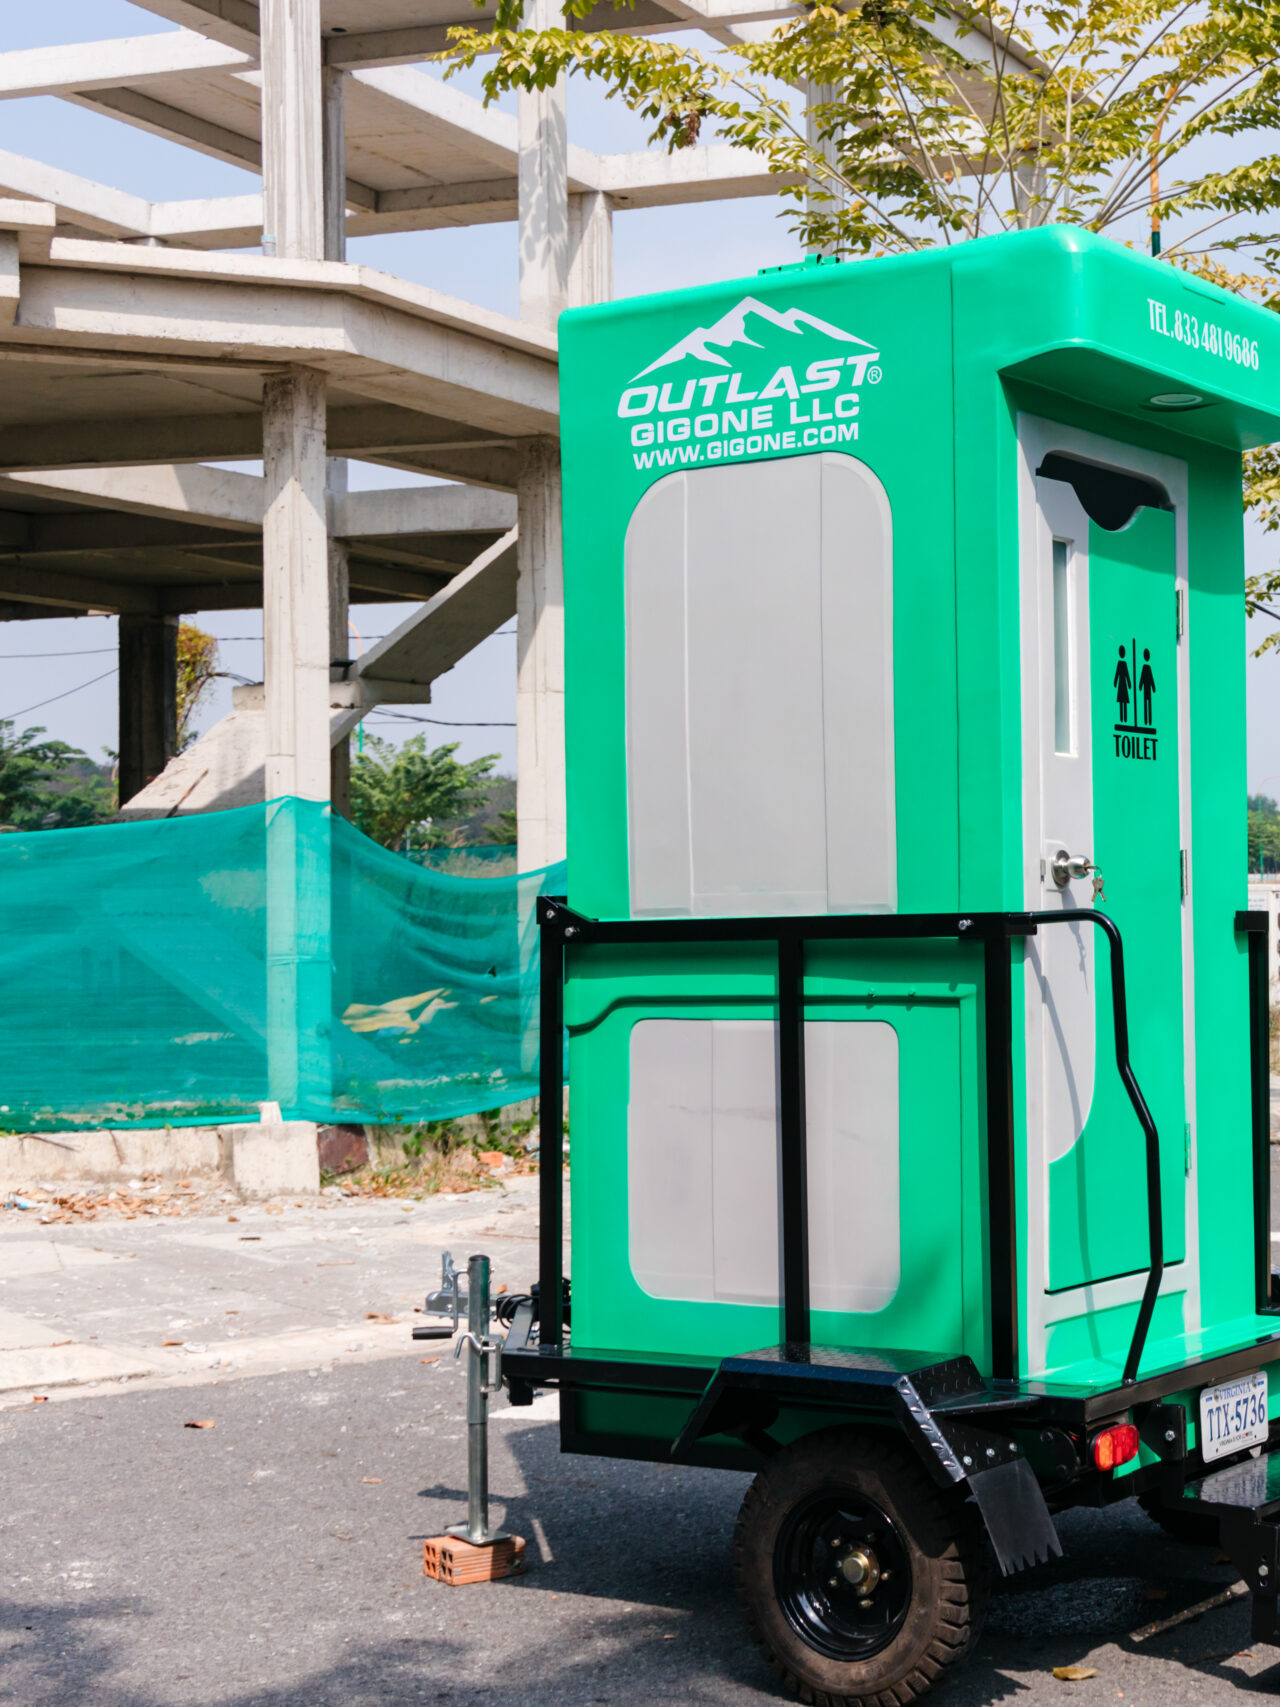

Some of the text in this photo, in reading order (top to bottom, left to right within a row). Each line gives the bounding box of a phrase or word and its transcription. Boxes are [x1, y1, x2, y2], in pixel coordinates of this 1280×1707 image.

[1201, 322, 1223, 357] 481
[1224, 330, 1259, 371] 9686
[630, 393, 860, 447] GIGONE LLC
[633, 422, 859, 470] WWW.GIGONE.COM
[1113, 734, 1158, 760] TOILET
[1219, 1381, 1251, 1400] VIRGINIA
[1207, 1391, 1265, 1442] TTX-5736
